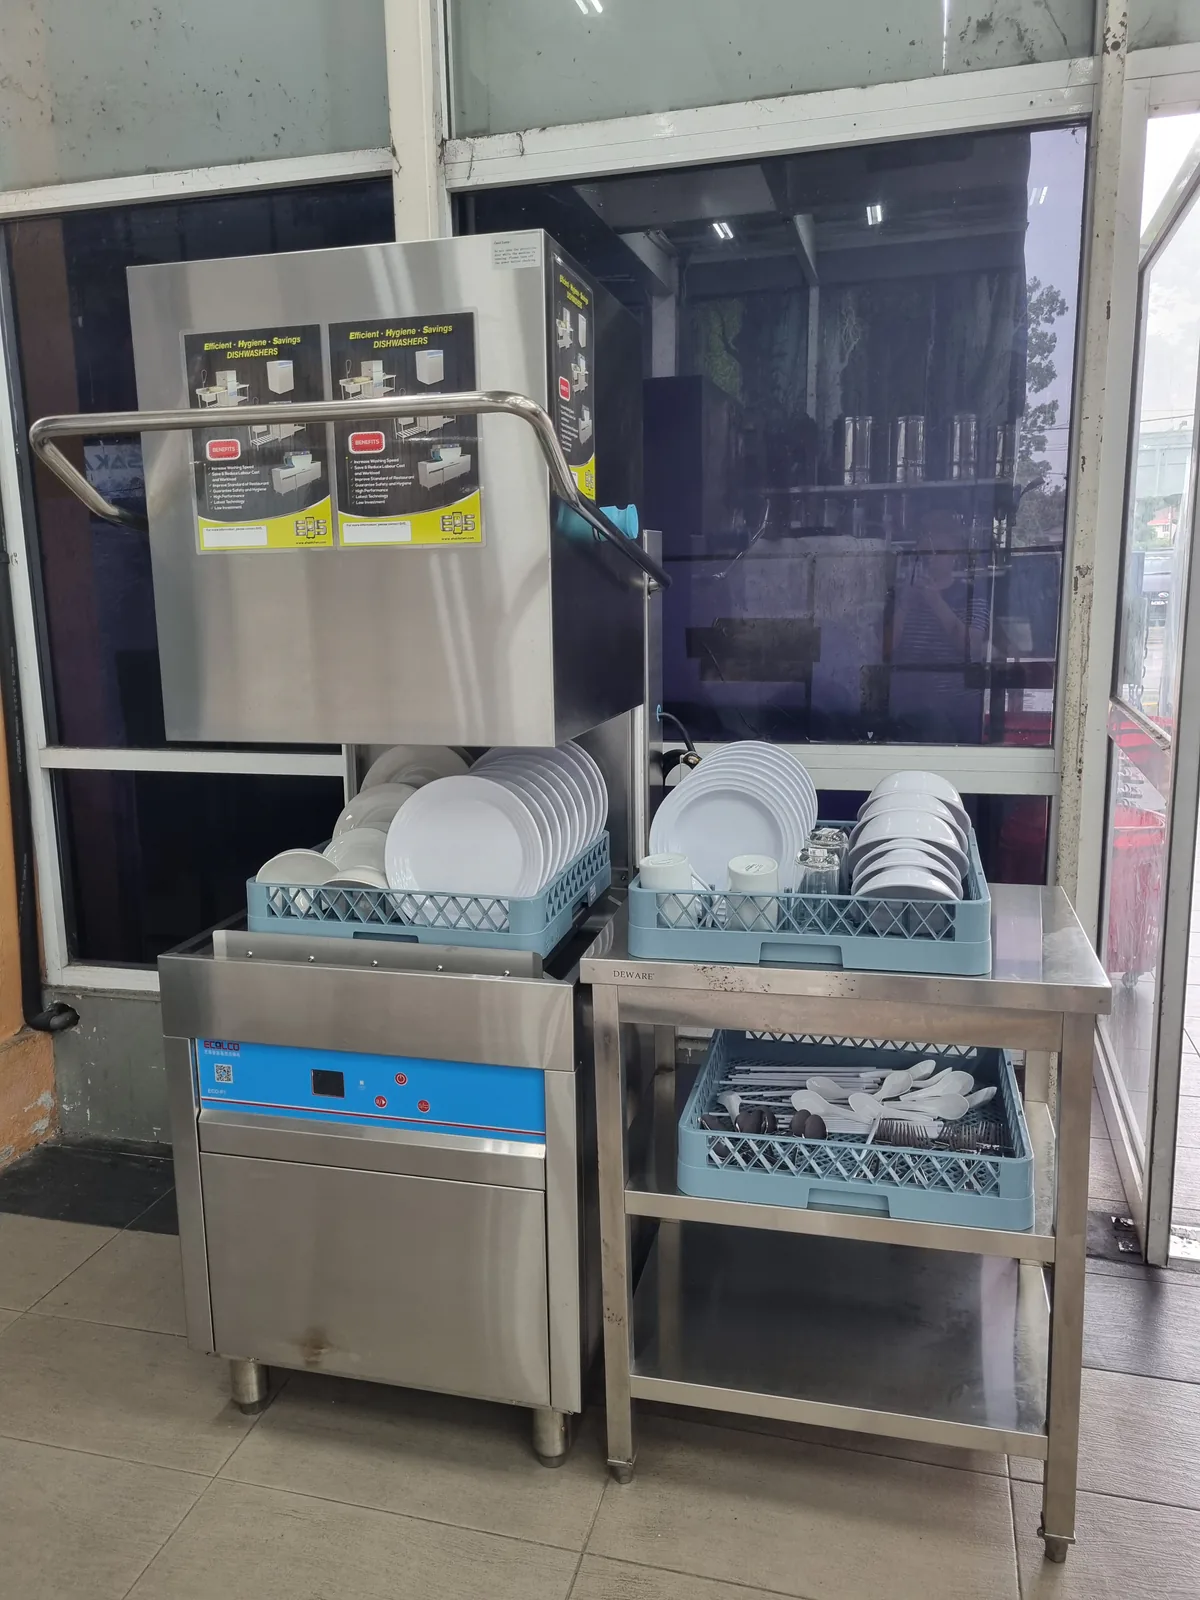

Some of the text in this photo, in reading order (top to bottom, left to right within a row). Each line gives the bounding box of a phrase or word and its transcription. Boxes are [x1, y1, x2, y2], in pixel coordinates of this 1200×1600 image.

[349, 324, 453, 340] Efficient Hygiene Savings
[204, 336, 301, 350] Efficient Hygiene Savings
[373, 337, 428, 349] DISHWASHERS
[226, 348, 278, 359] DISHWASHERS
